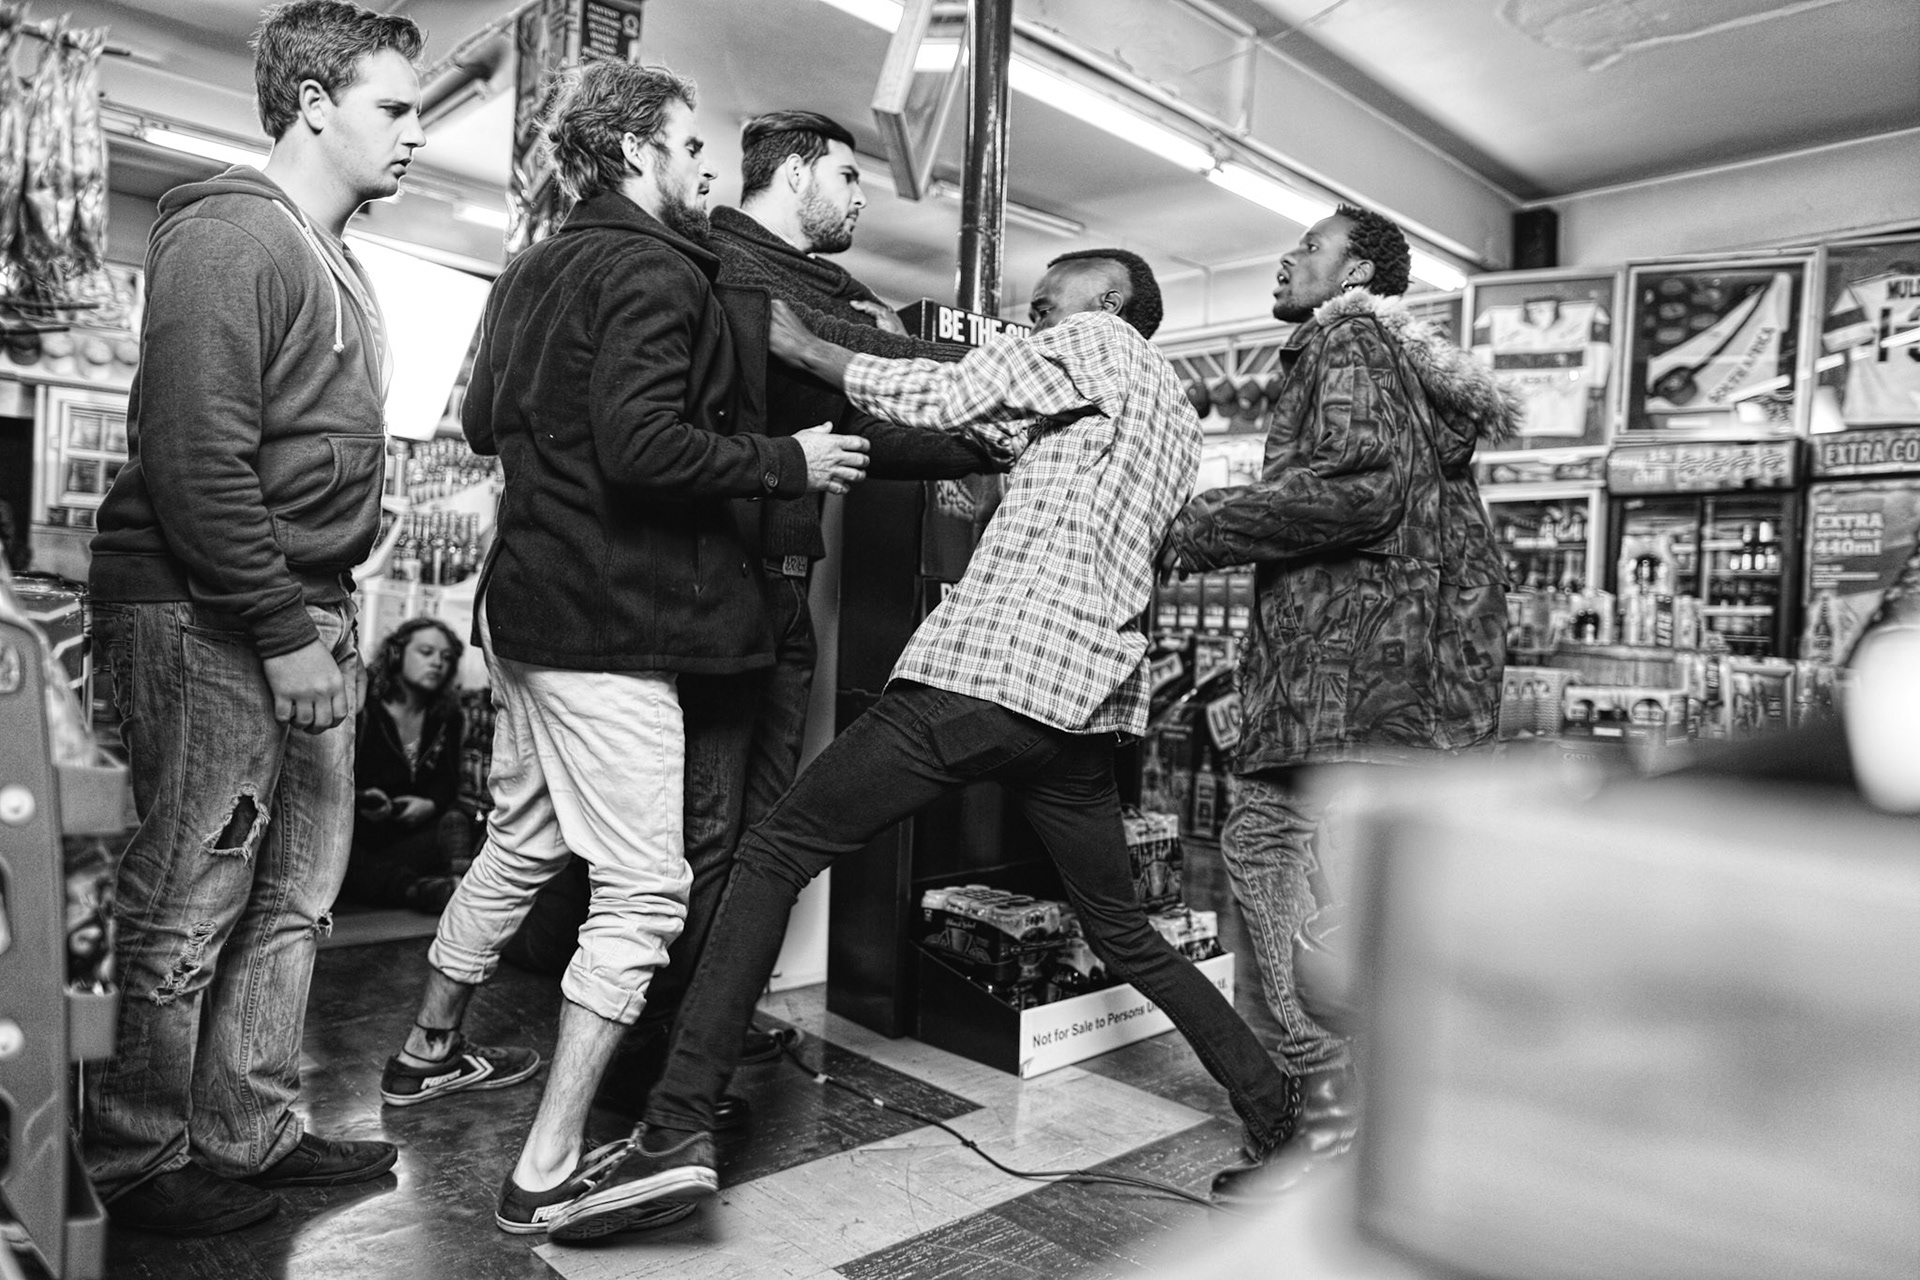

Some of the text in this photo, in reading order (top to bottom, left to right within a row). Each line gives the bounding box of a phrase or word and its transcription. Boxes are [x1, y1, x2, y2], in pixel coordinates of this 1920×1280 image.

[1888, 279, 1920, 299] MUL
[939, 306, 965, 342] BE
[1824, 439, 1920, 465] EXTRA CO
[1816, 512, 1884, 529] EXTRA
[1814, 539, 1882, 556] 440ml
[1033, 1034, 1053, 1049] Not
[1054, 1027, 1071, 1041] for
[1072, 1021, 1093, 1037] Sale
[1095, 1017, 1106, 1029] to
[1107, 1004, 1145, 1027] Persons
